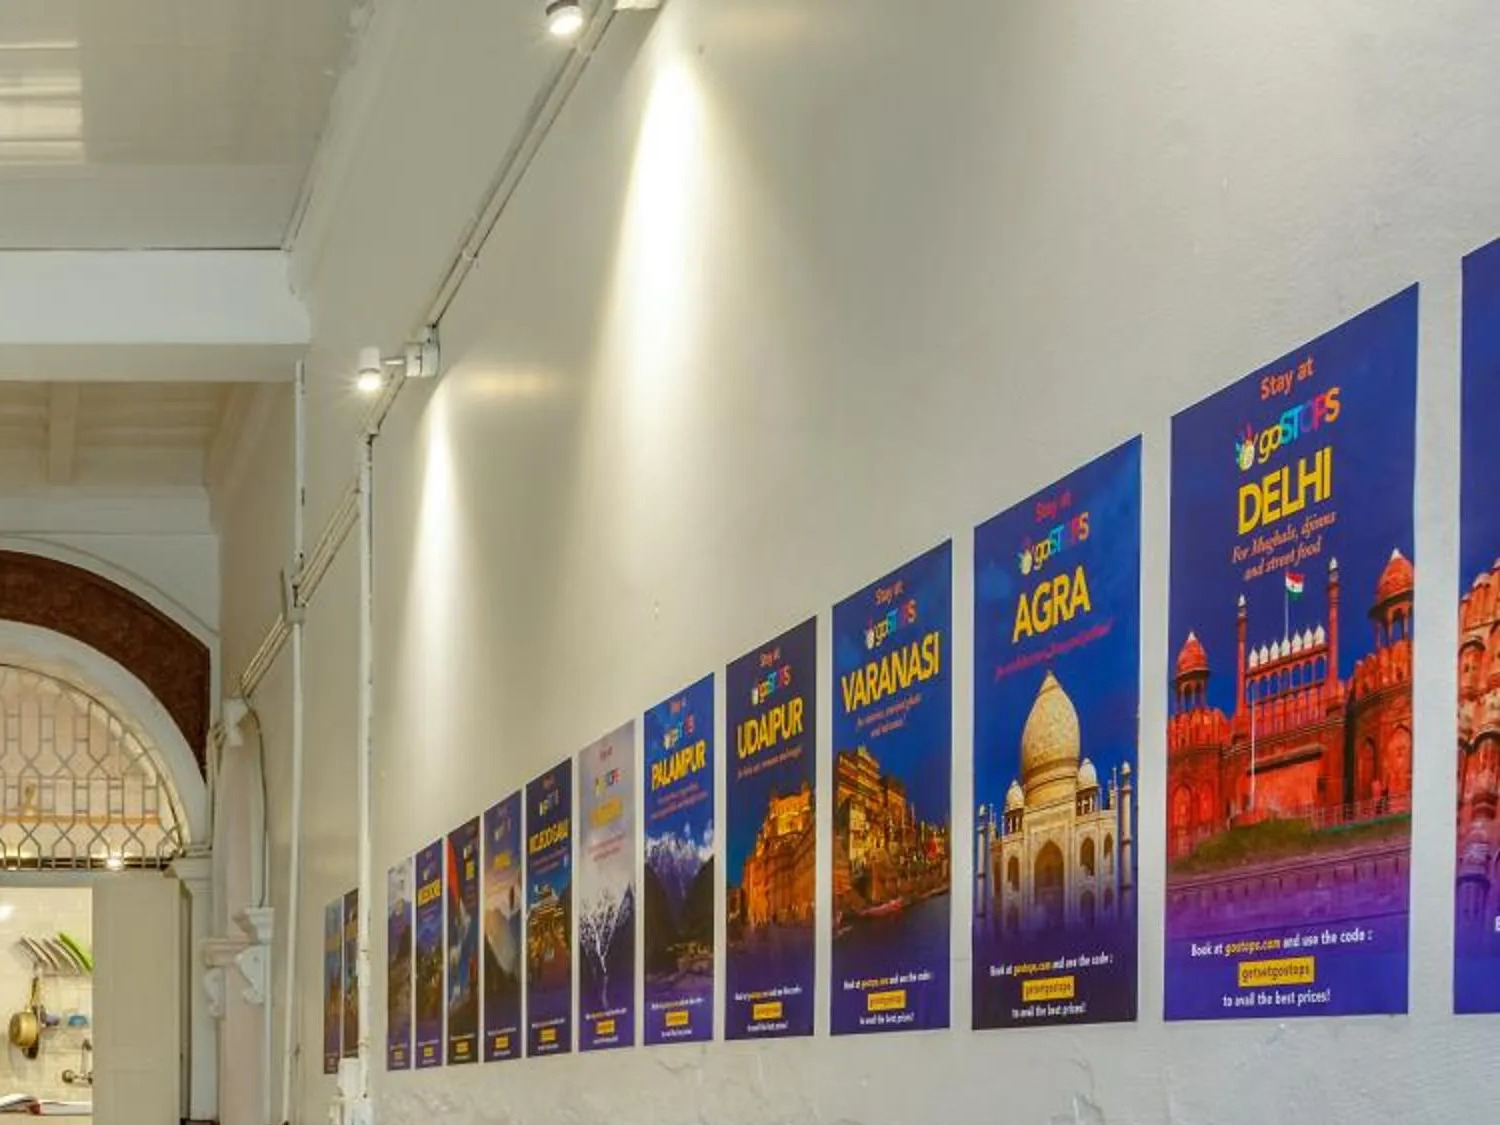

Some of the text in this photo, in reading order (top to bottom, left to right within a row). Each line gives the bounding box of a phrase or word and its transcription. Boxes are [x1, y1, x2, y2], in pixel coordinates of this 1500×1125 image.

[1261, 356, 1314, 400] Stay at
[1258, 387, 1340, 464] goSTOPS
[1238, 447, 1332, 535] DELHI
[1012, 564, 1091, 644] AGRA
[841, 631, 940, 713] VARANASI
[737, 696, 803, 759] UDAIPUR
[652, 739, 707, 791] PALAMPUR
[1191, 943, 1212, 957] Book
[1213, 943, 1223, 955] at
[1283, 933, 1300, 948] and
[1302, 935, 1318, 947] use
[1321, 929, 1337, 944] the
[1340, 927, 1365, 943] code
[1223, 995, 1234, 1007] to
[1257, 991, 1273, 1005] the
[1275, 990, 1295, 1004] best
[1297, 989, 1331, 1006] prices!
